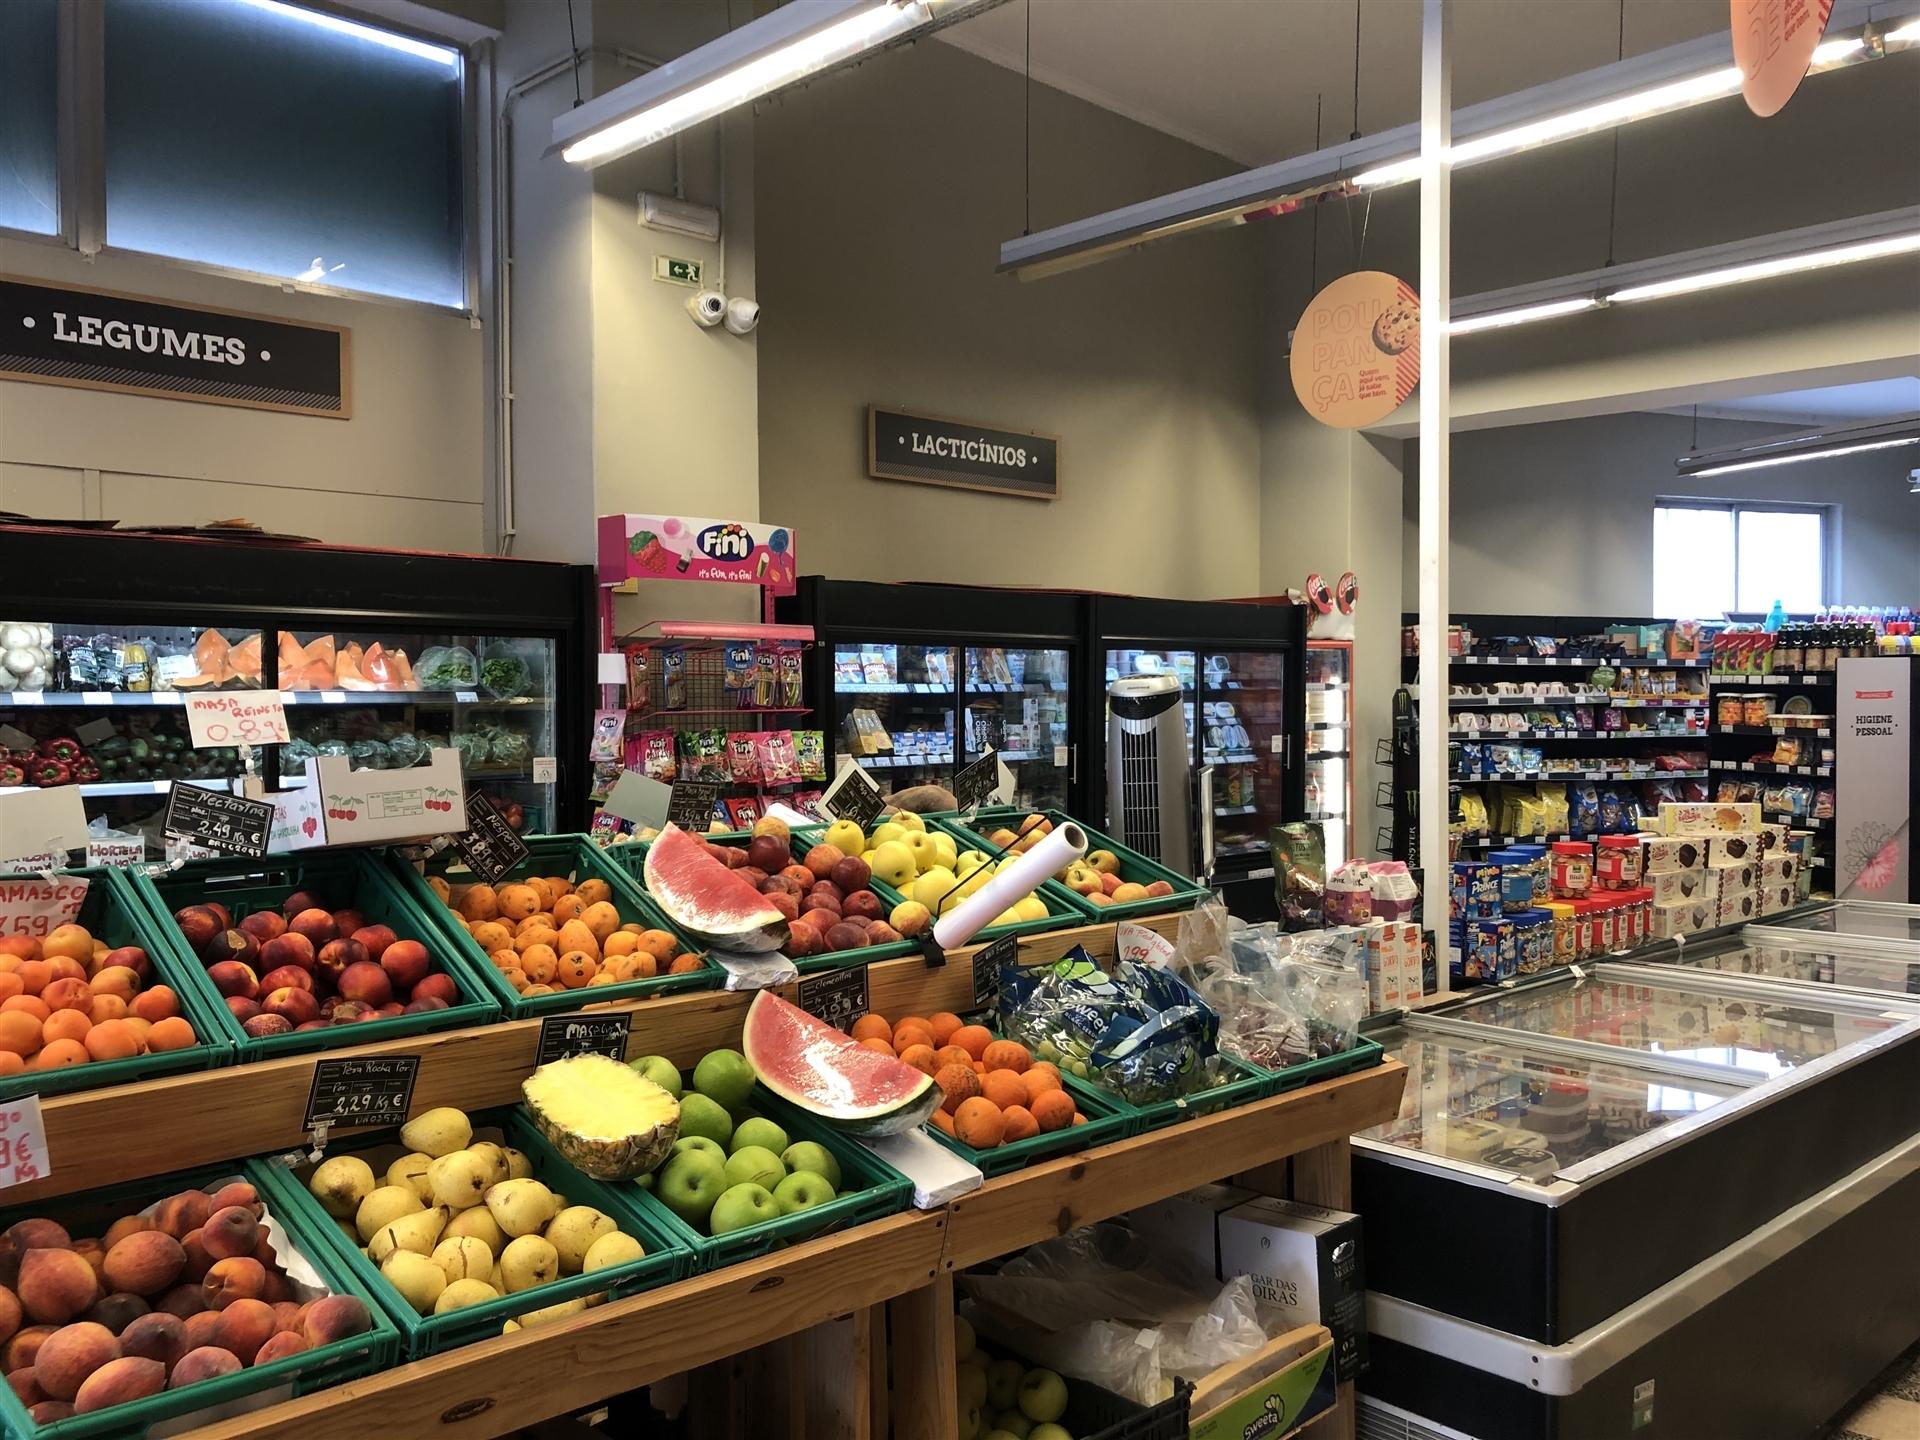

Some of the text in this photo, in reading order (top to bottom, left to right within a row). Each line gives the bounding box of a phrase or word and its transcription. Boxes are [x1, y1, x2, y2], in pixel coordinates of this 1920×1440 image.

[1313, 298, 1381, 339] POU
[53, 312, 246, 366] LEGUMES
[1313, 336, 1377, 372] PAN
[1311, 373, 1355, 413] ÇA
[912, 433, 1027, 468] LACTICÍNIOS
[703, 529, 748, 558] Fini
[731, 648, 750, 662] Fini
[1856, 715, 1893, 724] HIGIENE
[1856, 727, 1894, 737] PESSOAL
[197, 820, 231, 838] 2,49
[250, 832, 261, 844] €
[333, 1094, 372, 1115] 2,29
[393, 1094, 403, 1107] €
[1275, 1278, 1298, 1292] DAS
